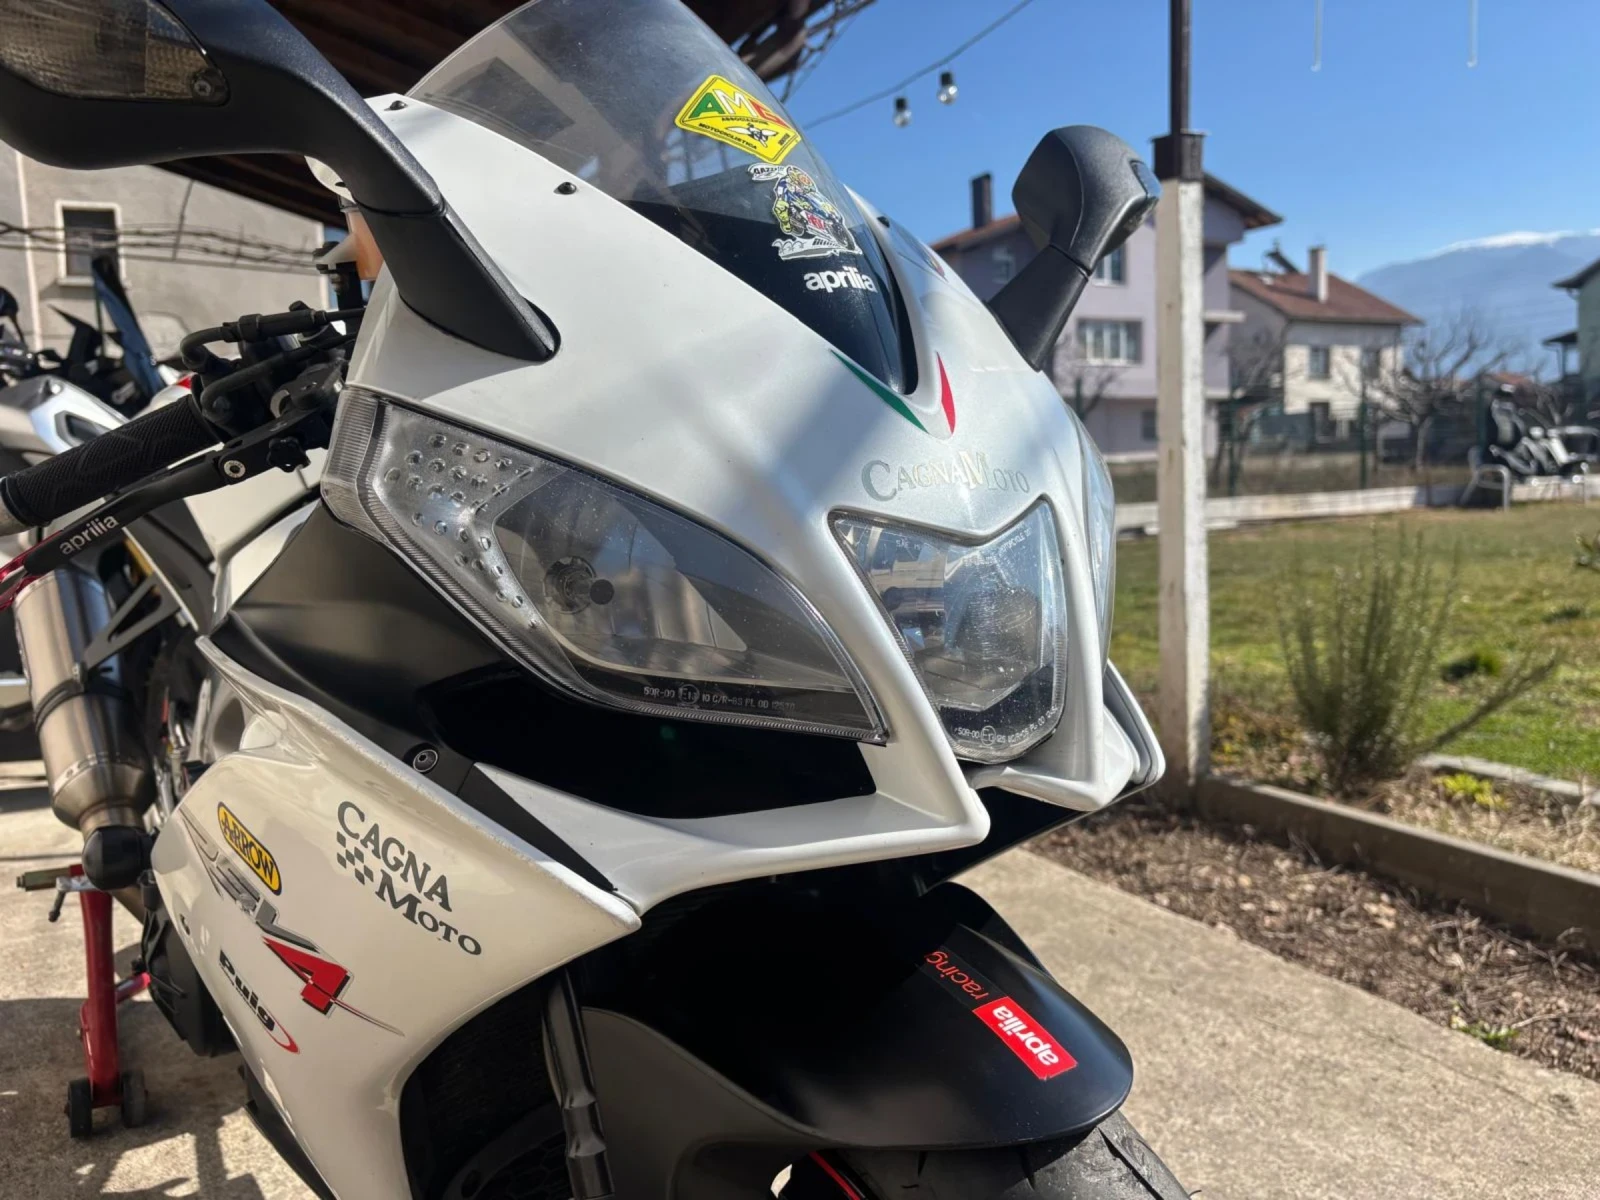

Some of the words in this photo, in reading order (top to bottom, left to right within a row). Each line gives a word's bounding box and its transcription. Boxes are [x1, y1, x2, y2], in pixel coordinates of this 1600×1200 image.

[803, 265, 879, 293] aprilia
[59, 513, 119, 555] aprilia
[221, 811, 276, 885] ARROW
[337, 801, 453, 912] CAGNA
[375, 869, 482, 956] MOTO
[219, 950, 276, 1032] Puig
[926, 950, 989, 1000] racing
[992, 1005, 1059, 1066] aprilia
